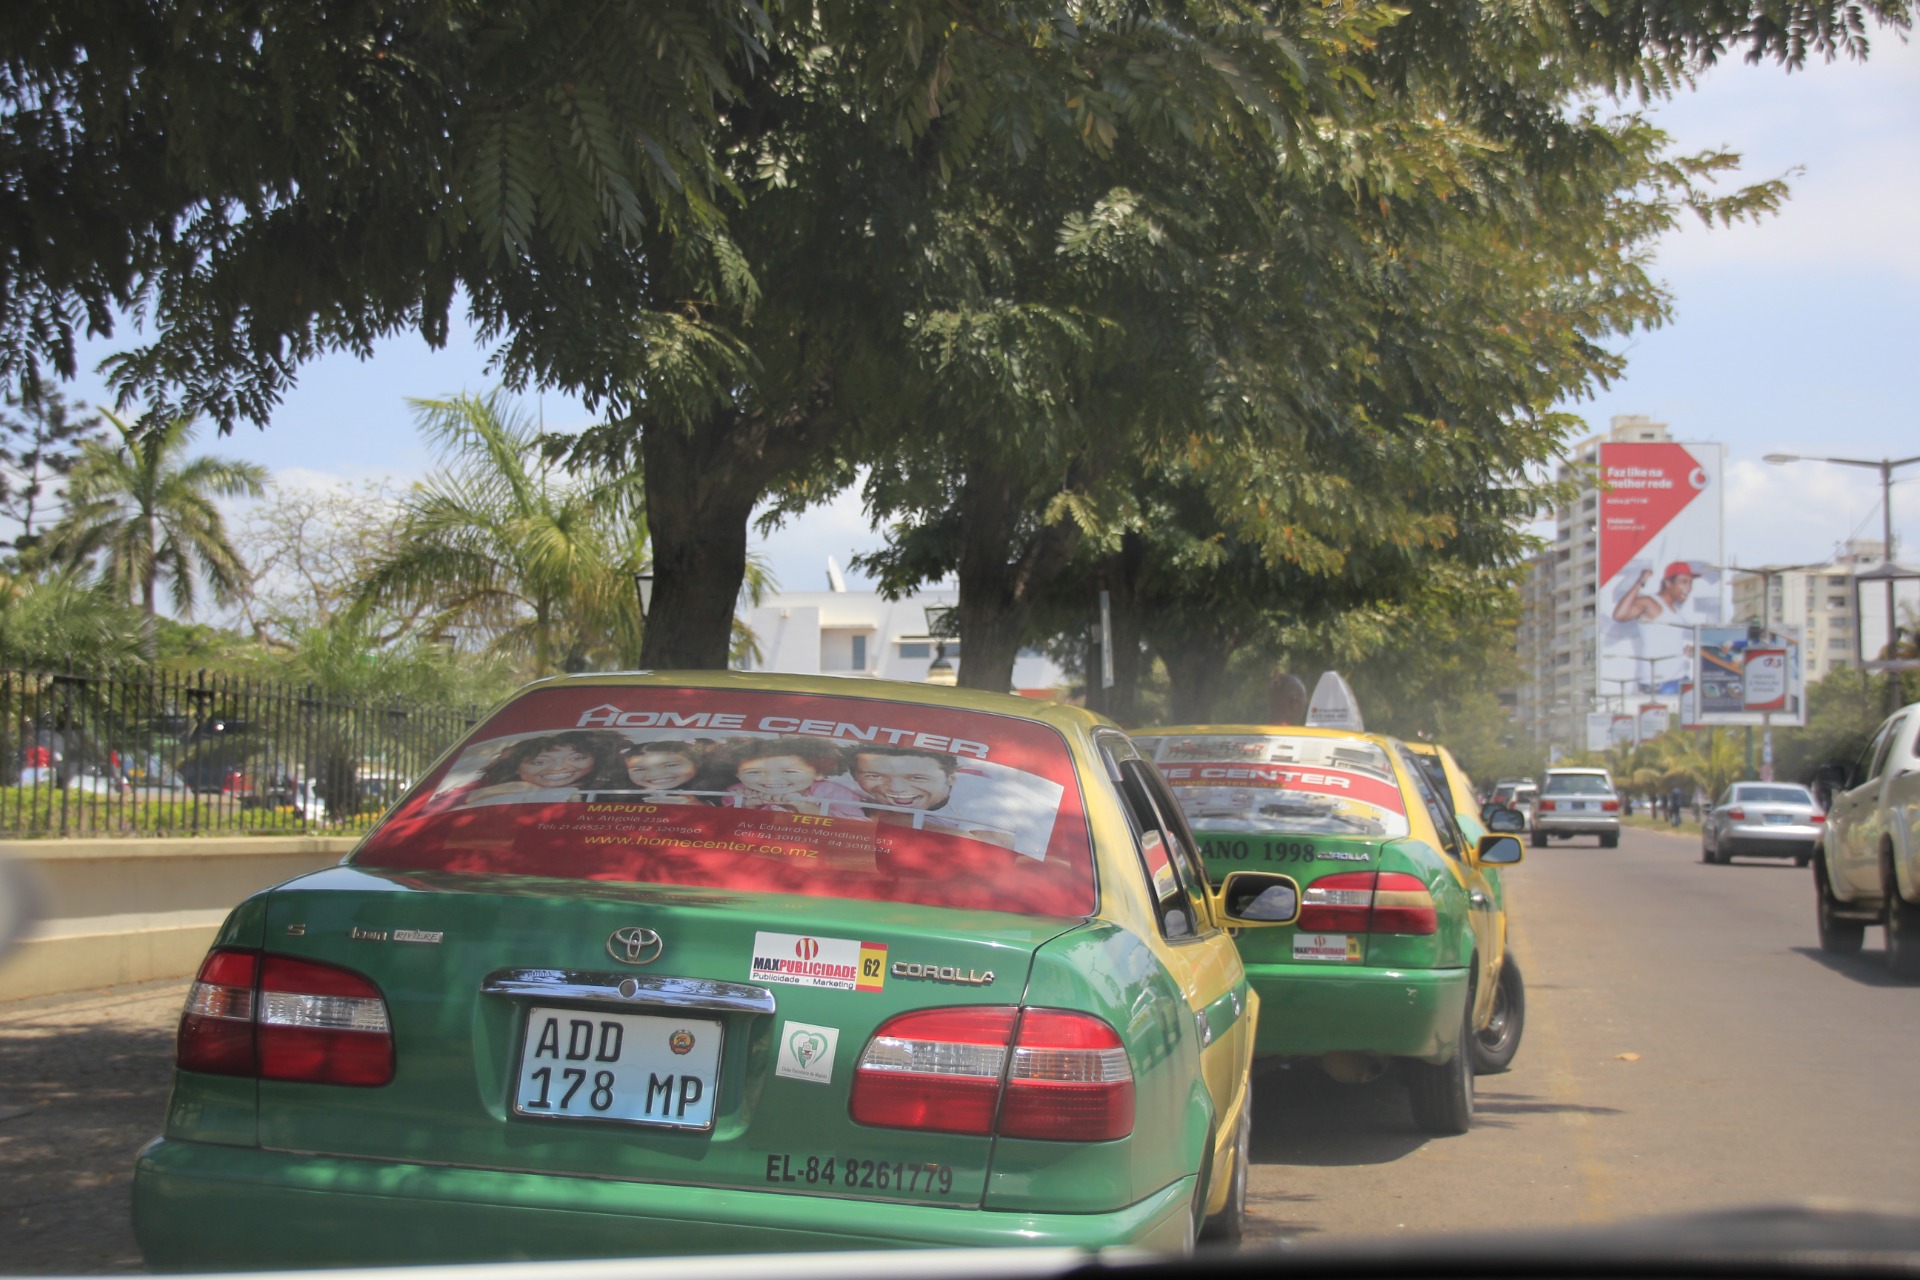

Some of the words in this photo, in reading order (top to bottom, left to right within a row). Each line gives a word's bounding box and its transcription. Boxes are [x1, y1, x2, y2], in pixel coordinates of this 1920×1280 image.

[1607, 467, 1626, 478] Faz
[1627, 467, 1648, 478] like
[1649, 469, 1663, 478] na
[1648, 479, 1673, 489] rede
[576, 704, 747, 728] HOME
[758, 716, 990, 759] CENTER
[1200, 767, 1350, 789] CENTER
[587, 805, 657, 813] MAPUTO
[792, 815, 835, 827] TETE
[759, 823, 808, 834] Eduardo
[812, 828, 871, 842] Mondlane
[585, 835, 819, 859] www.homecenter.co.mz
[1201, 840, 1249, 860] ANO
[1263, 842, 1315, 863] 1998
[863, 958, 880, 978] 62
[891, 961, 995, 984] COROLLA
[753, 972, 800, 984] Publicidade
[813, 978, 854, 990] Marketing
[535, 1018, 624, 1062] ADD
[527, 1067, 615, 1111] 178
[645, 1072, 704, 1117] MP
[766, 1154, 835, 1185] EL-84
[844, 1158, 953, 1194] 8261779
